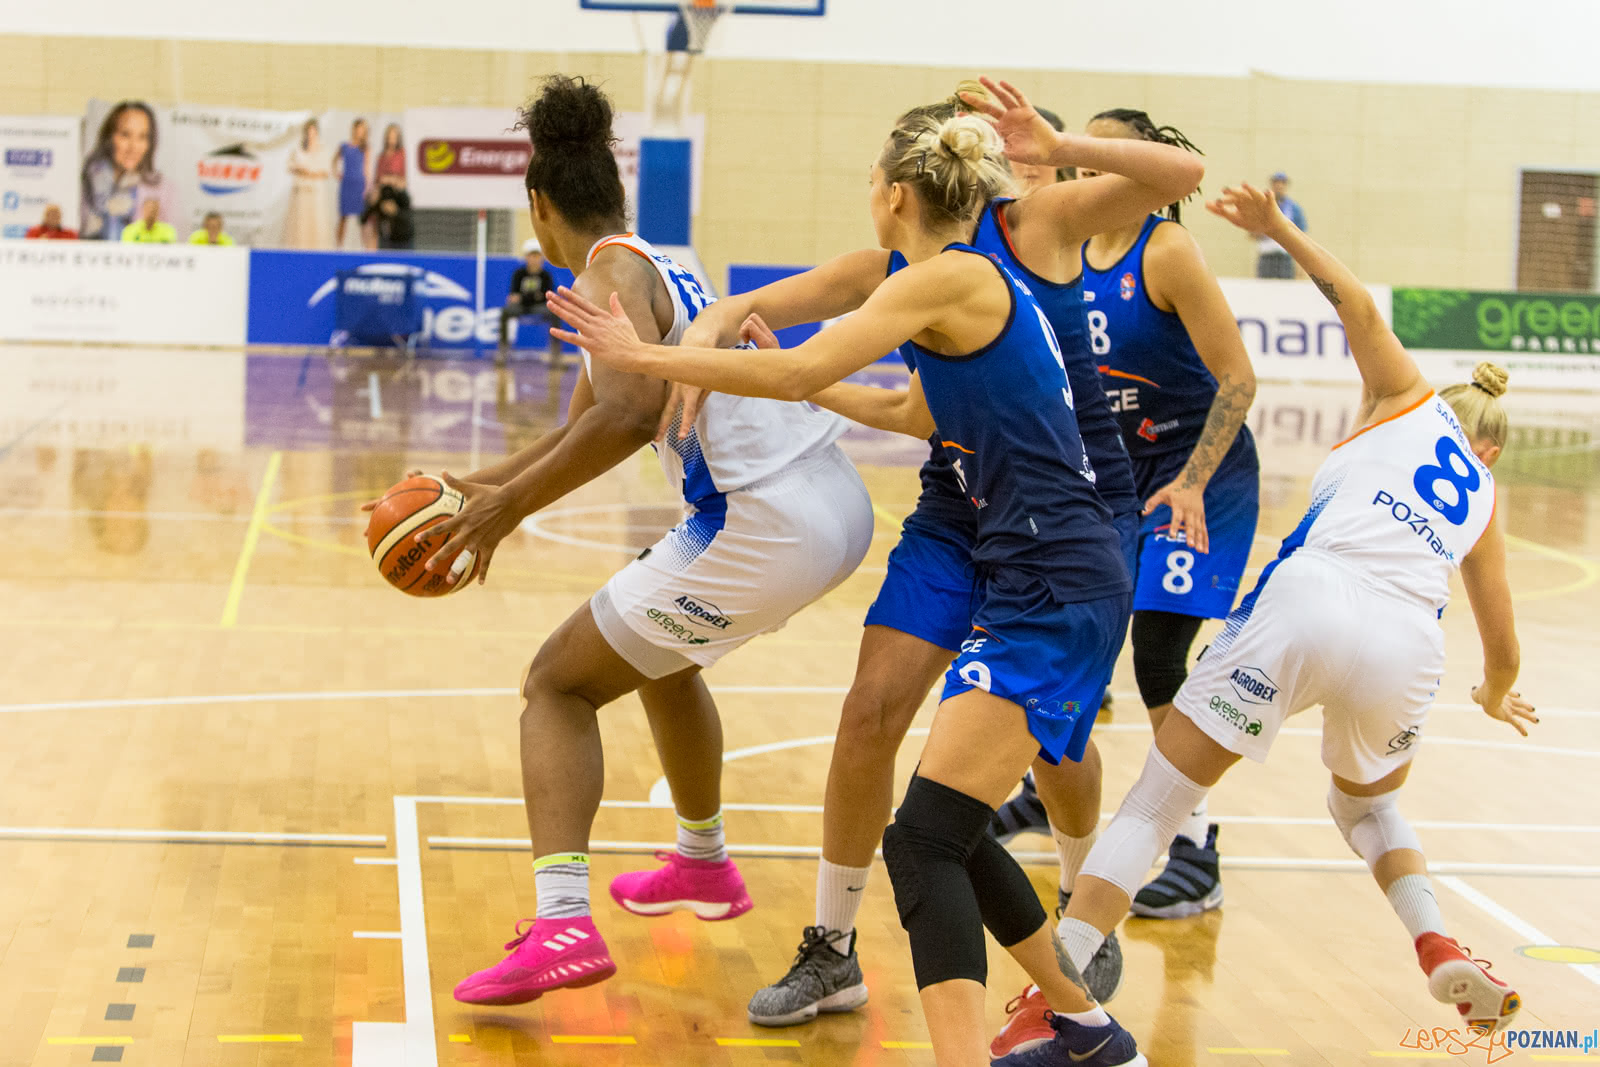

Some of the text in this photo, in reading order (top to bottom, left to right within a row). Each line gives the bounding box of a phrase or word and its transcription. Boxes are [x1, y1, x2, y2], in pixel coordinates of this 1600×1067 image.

[459, 146, 528, 170] Energa
[1087, 310, 1111, 355] 8
[1413, 435, 1481, 526] 8
[1162, 549, 1195, 595] 8
[647, 608, 694, 640] green
[1230, 668, 1278, 703] AGROBEX
[1209, 695, 1248, 726] green
